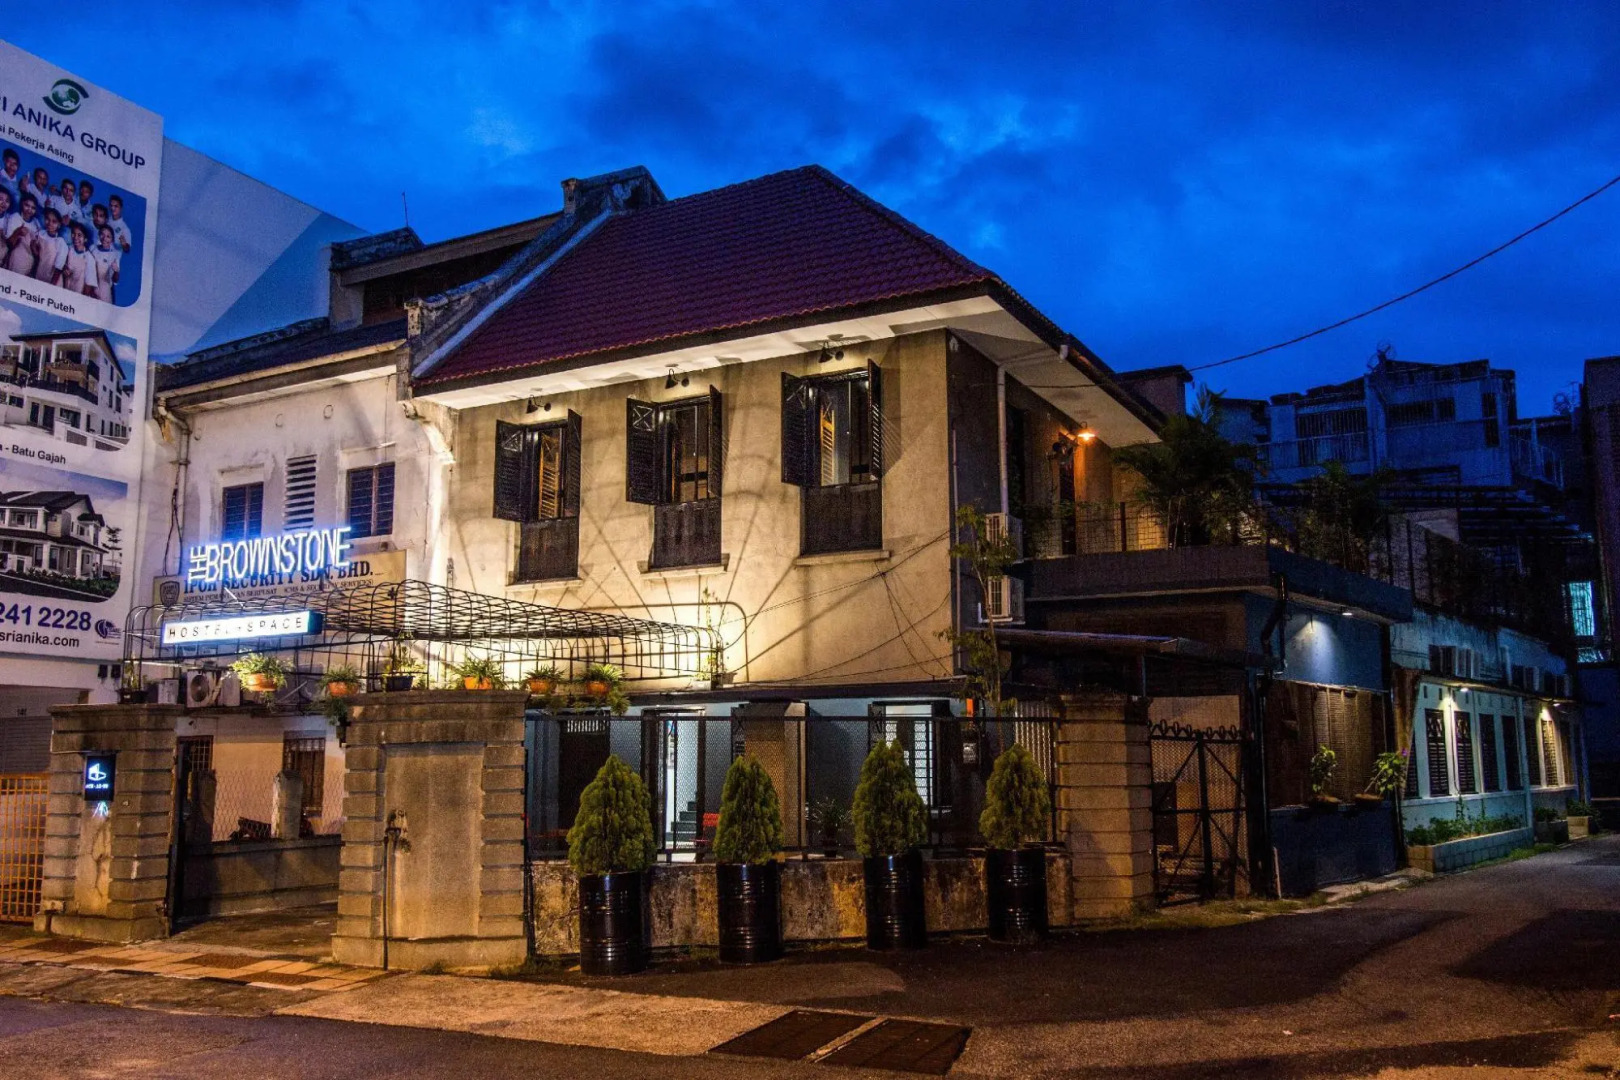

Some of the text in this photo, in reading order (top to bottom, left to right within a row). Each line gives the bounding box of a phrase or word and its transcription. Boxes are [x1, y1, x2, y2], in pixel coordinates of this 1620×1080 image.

[8, 127, 45, 149] Pekerja
[47, 144, 74, 164] Asing
[12, 103, 75, 142] ANIKA
[80, 132, 146, 169] GROUP
[20, 289, 45, 305] Pasir
[47, 298, 75, 314] Puteh
[12, 444, 35, 458] Batu
[37, 450, 66, 465] Gajah
[188, 546, 207, 584] THE
[205, 526, 351, 583] BROWNSTONE
[338, 560, 373, 579] BHD.
[38, 606, 92, 631] 2228
[246, 617, 302, 633] SPACE
